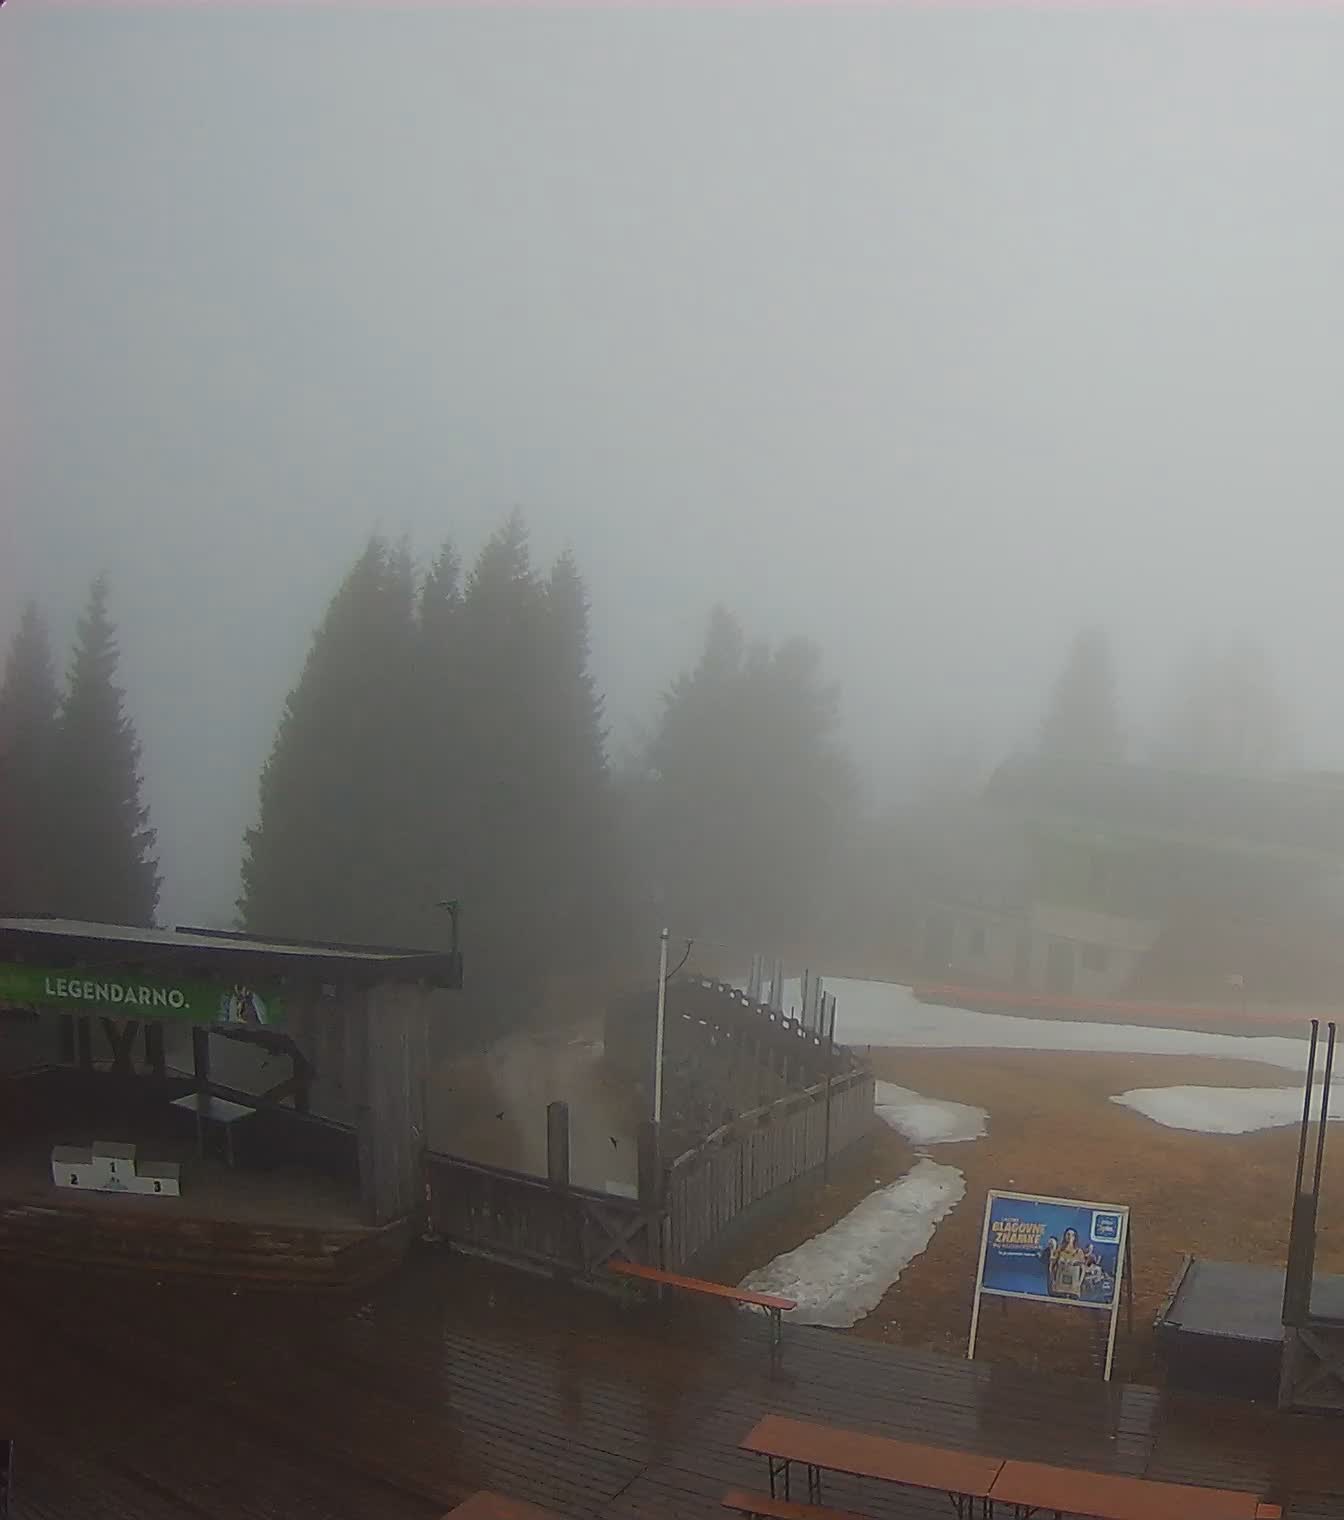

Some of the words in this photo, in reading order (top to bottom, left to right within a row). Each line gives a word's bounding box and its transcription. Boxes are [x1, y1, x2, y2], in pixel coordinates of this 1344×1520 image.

[45, 977, 190, 1009] LEGENDARNO.
[109, 1161, 116, 1174] 1
[69, 1173, 79, 1185] 2
[153, 1180, 162, 1193] 3
